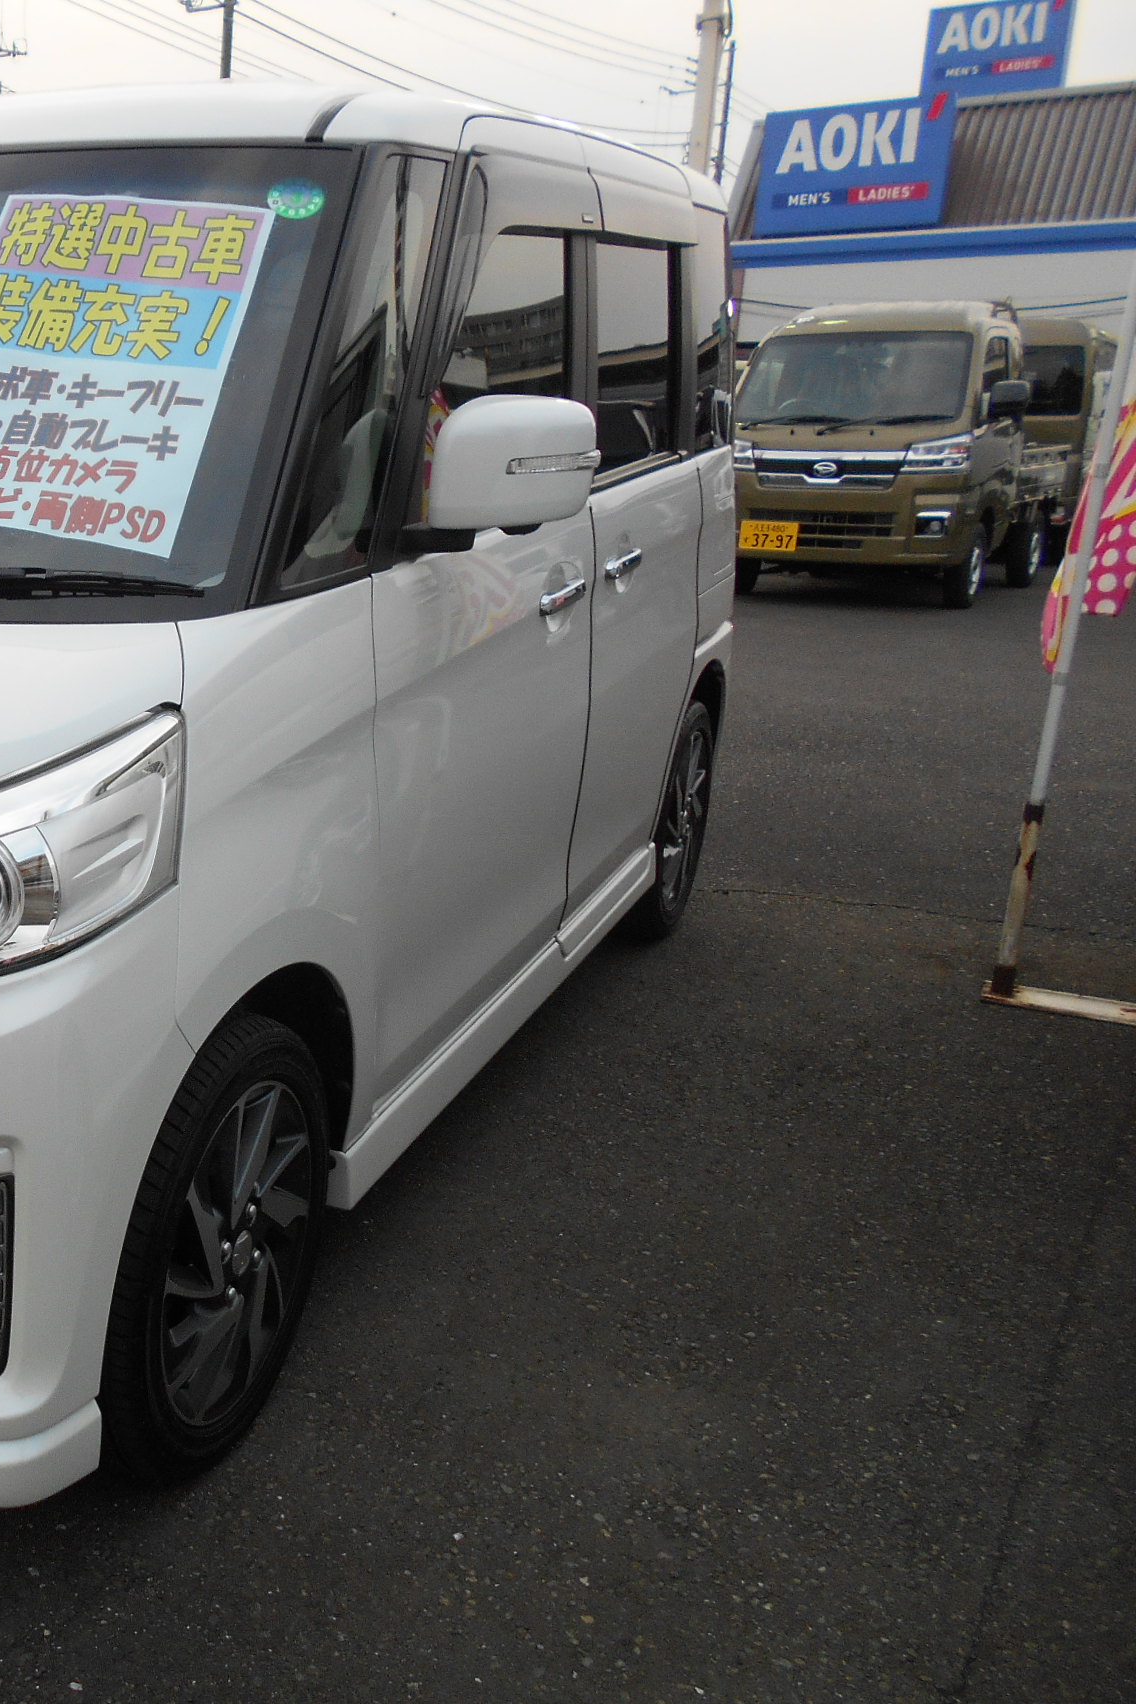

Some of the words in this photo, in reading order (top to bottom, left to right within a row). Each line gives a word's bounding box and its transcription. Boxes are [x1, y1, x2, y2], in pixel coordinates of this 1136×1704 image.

[936, 2, 1049, 54] AOKI
[945, 64, 980, 77] MEN'S
[775, 107, 923, 175] AOKI
[787, 191, 831, 207] MEN'S
[752, 533, 793, 549] 37-97
